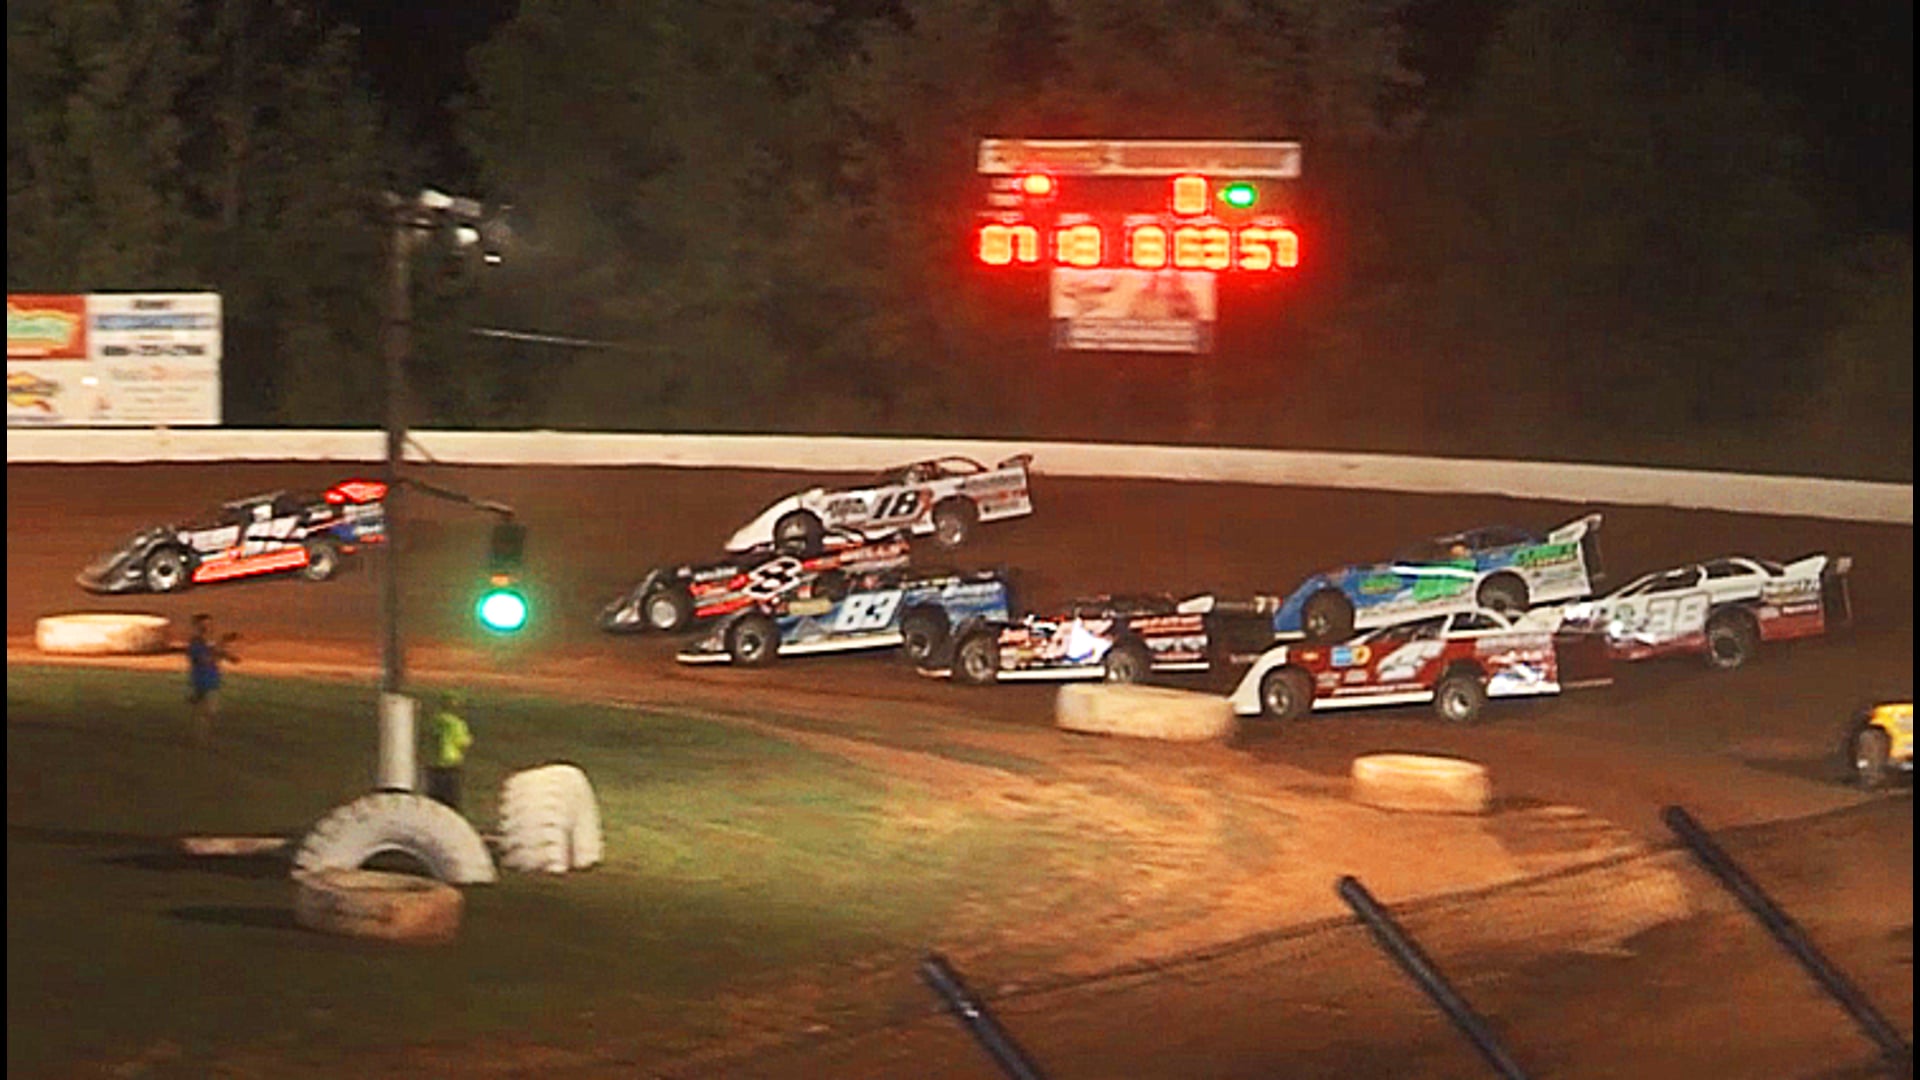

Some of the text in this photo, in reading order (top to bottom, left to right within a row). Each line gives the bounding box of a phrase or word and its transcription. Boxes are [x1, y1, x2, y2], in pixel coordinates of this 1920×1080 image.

[1240, 228, 1298, 269] 57
[872, 489, 921, 519] 18
[835, 590, 904, 632] 83
